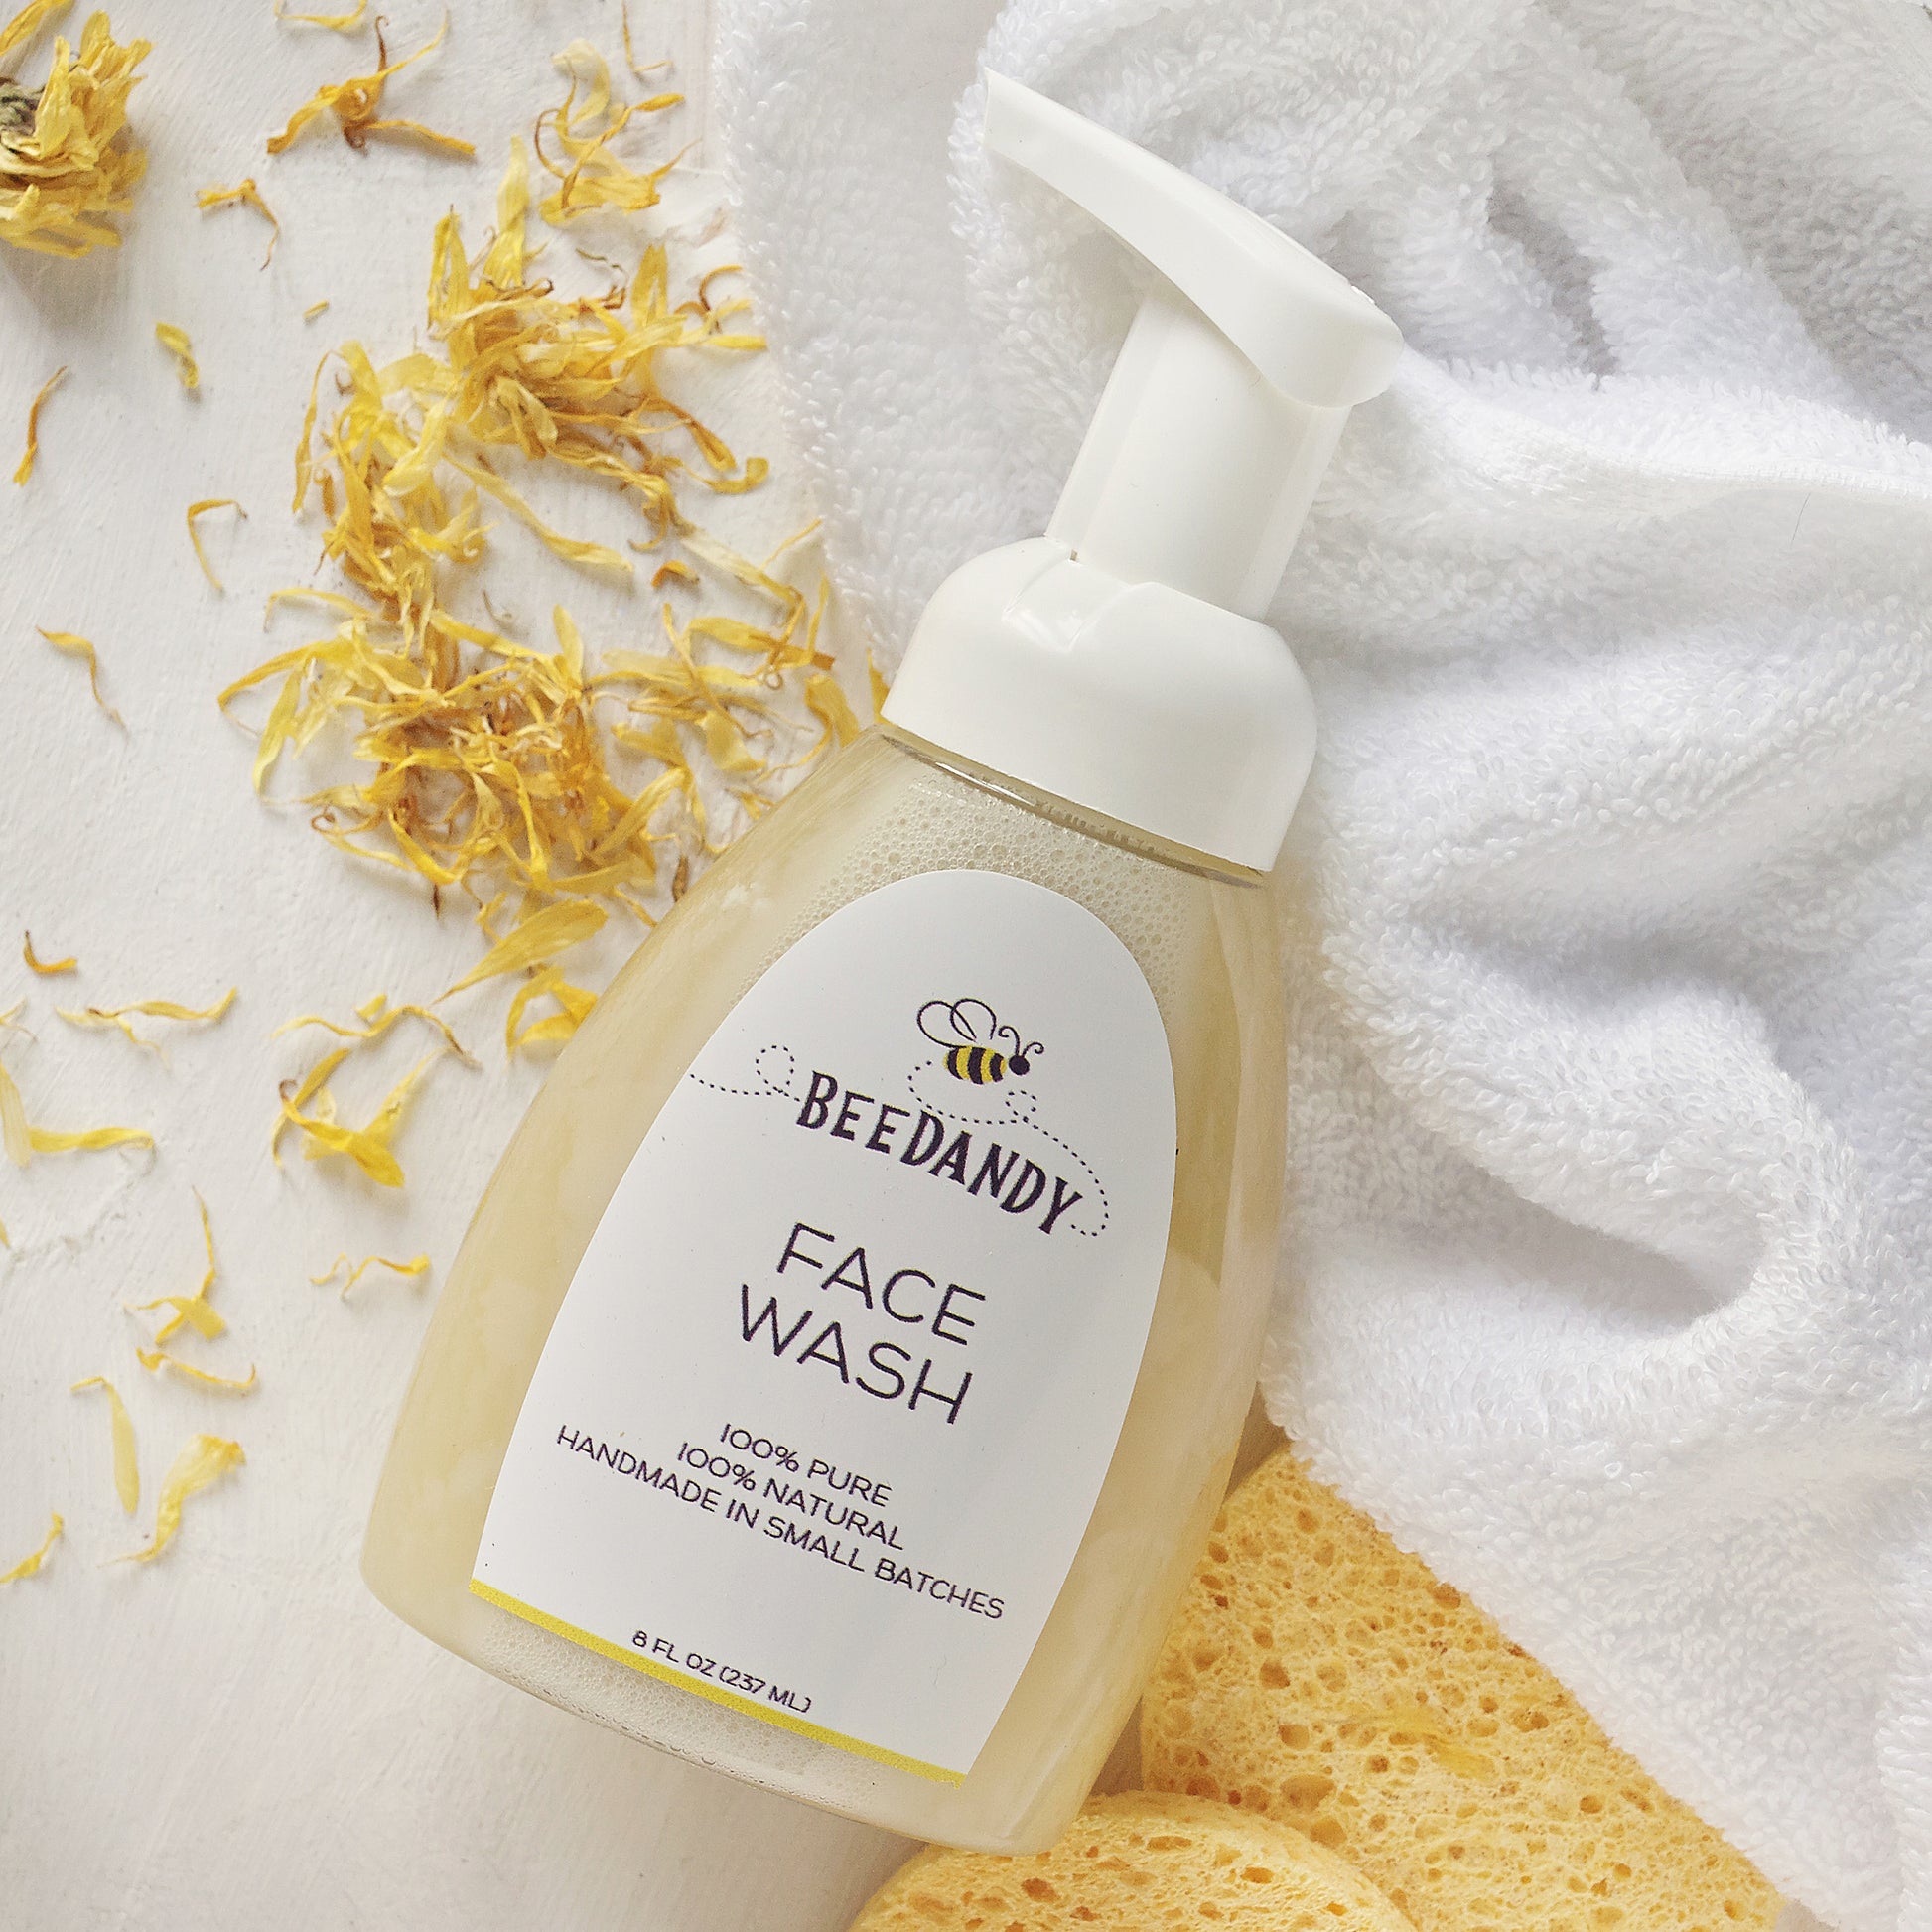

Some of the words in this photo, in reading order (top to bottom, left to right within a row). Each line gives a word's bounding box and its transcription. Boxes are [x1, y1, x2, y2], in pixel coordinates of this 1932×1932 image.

[795, 1069, 1083, 1234] BEEDANDY
[775, 1222, 986, 1345] FACE
[741, 1283, 973, 1425] WASH
[556, 1424, 723, 1513] HANDMADE
[725, 1498, 759, 1529] IN
[763, 1515, 866, 1572] SMALL
[874, 1557, 1005, 1620] BATCHES
[677, 1442, 756, 1491] 100%
[762, 1477, 904, 1550] NATURAL
[719, 1423, 799, 1472] 100%
[806, 1458, 893, 1507] PURE
[631, 1630, 648, 1648] 8
[651, 1637, 680, 1664] FL
[685, 1652, 718, 1678] OZ
[718, 1665, 767, 1695] (237
[767, 1685, 812, 1714] ML)
